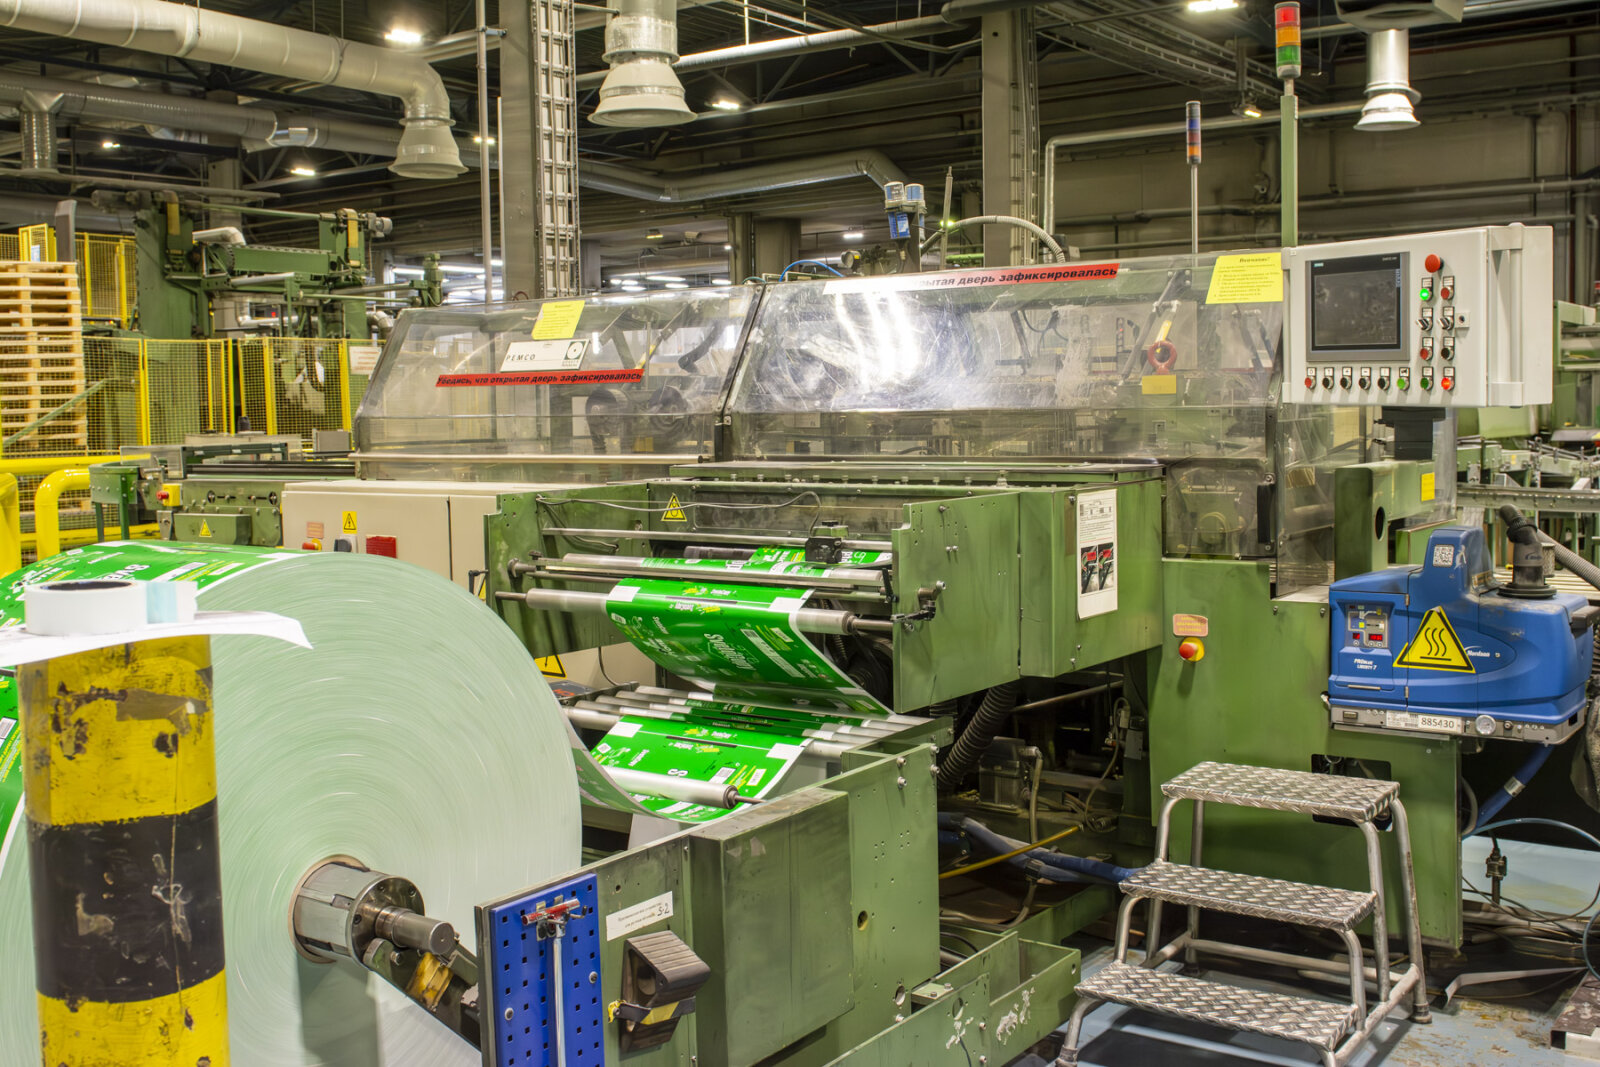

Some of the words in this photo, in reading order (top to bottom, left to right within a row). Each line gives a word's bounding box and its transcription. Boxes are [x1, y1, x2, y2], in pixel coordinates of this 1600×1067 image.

[957, 275, 995, 285] дверь
[999, 268, 1117, 282] зафиксировалась
[506, 353, 536, 361] PEMCO
[490, 376, 529, 384] открытая
[531, 375, 558, 383] дверь
[560, 372, 642, 382] зафиксировалась
[1420, 717, 1455, 729] 885430
